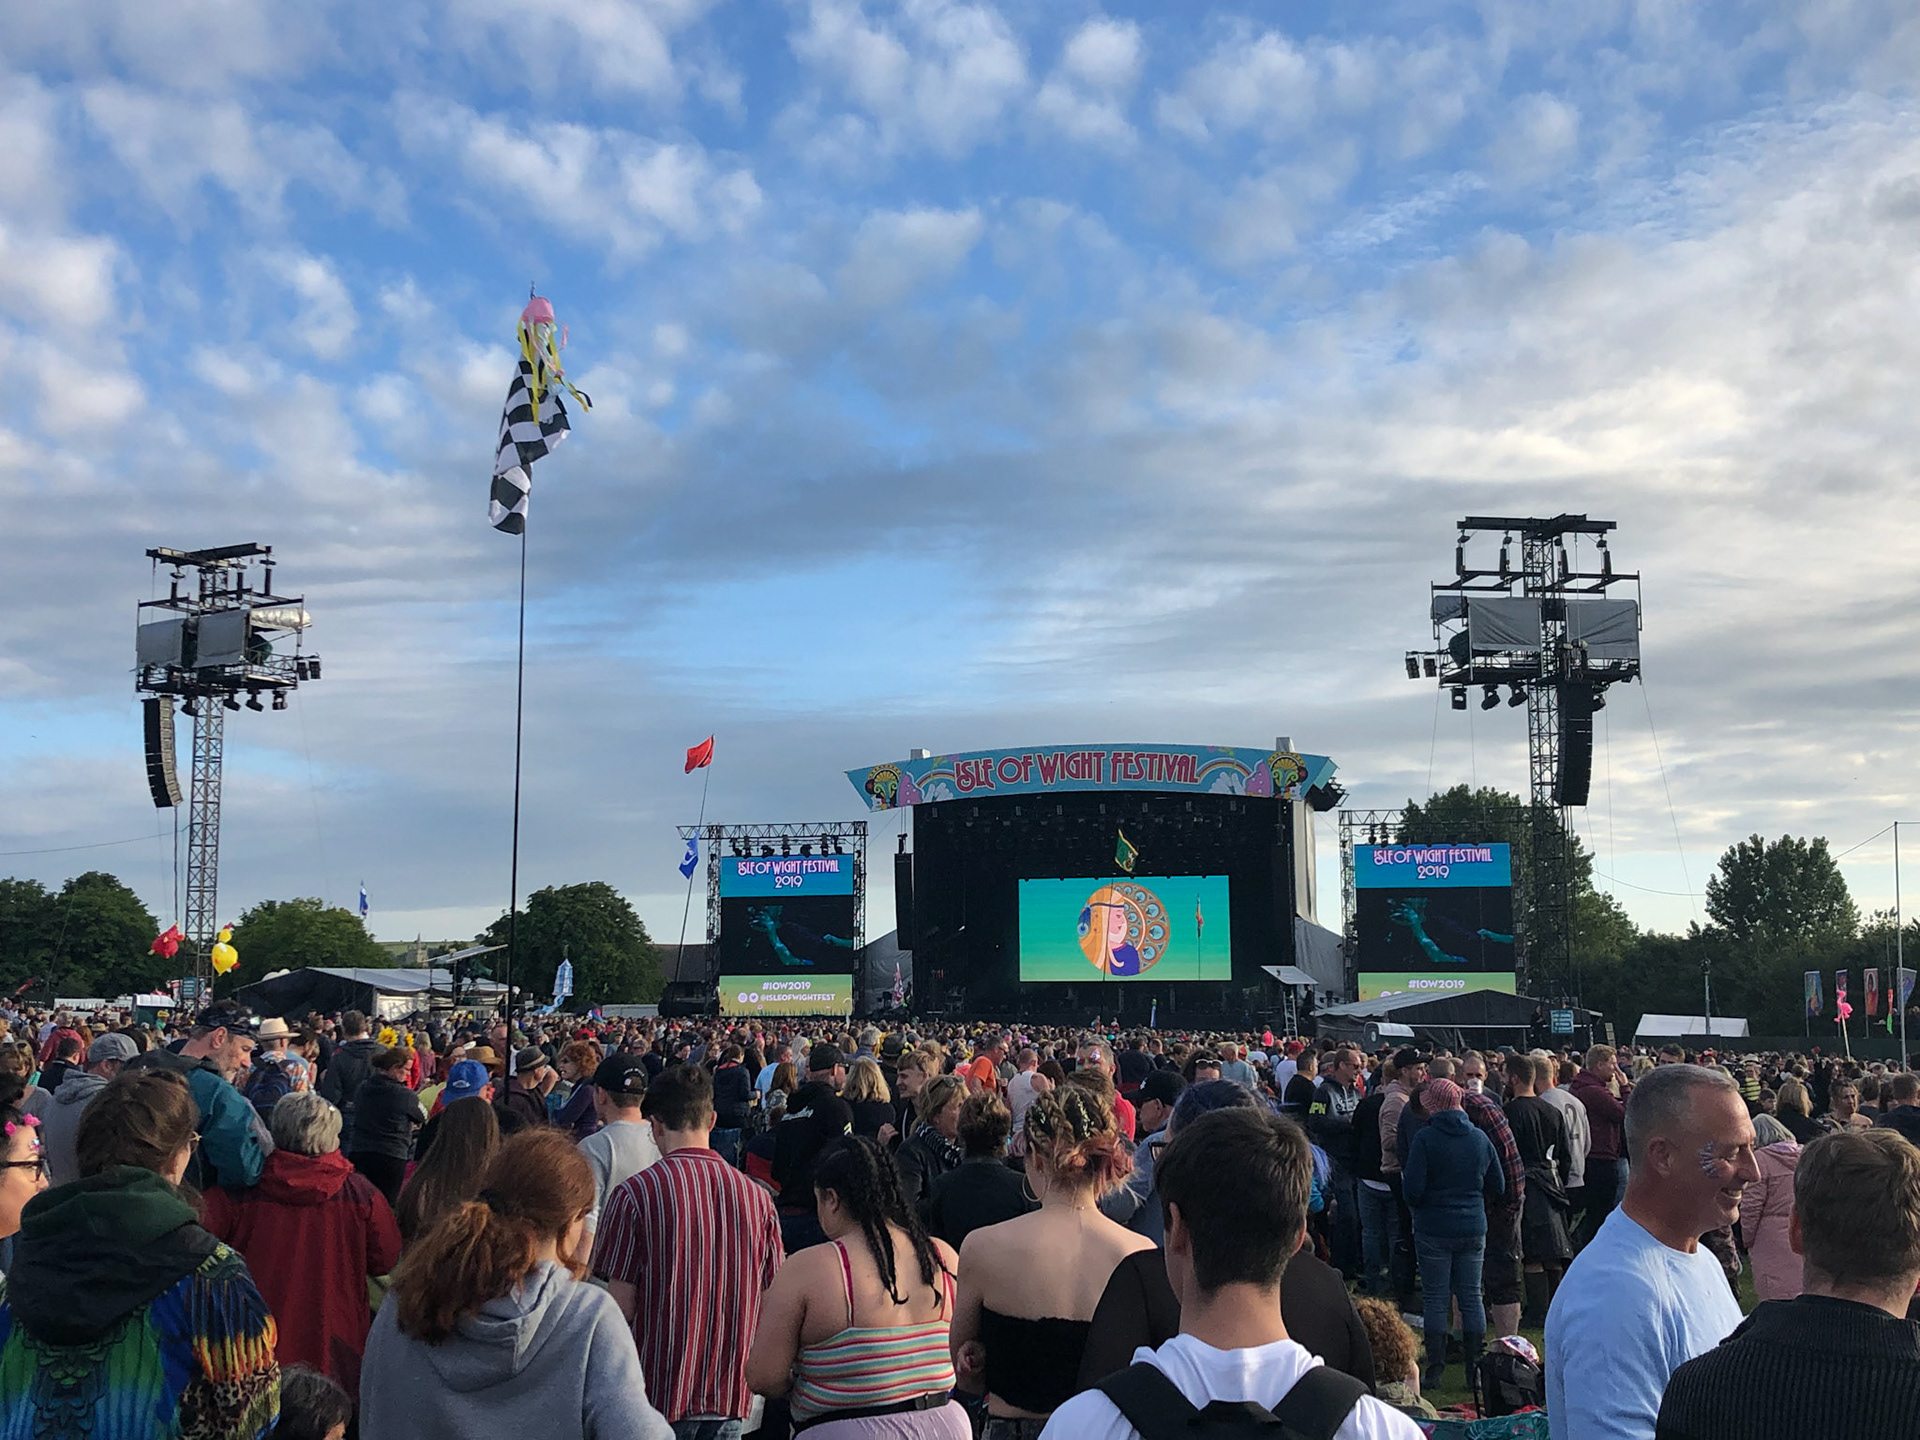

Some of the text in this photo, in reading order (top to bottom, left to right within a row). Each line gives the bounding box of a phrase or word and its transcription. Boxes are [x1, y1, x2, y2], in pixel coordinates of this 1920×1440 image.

[955, 752, 1200, 792] ISLE OF WIGHT FESTIVAL
[1373, 848, 1493, 865] ISLE OF WIGHT FESTIVAL
[738, 859, 840, 876] ISLE OF WIGHT FESTIVAL
[1417, 865, 1450, 879] 2019
[775, 875, 803, 888] 2019
[762, 981, 811, 990] #IOW2019
[1408, 979, 1465, 989] #IOW2019
[760, 993, 836, 1001] @ISLEOFWIGHTFEST
